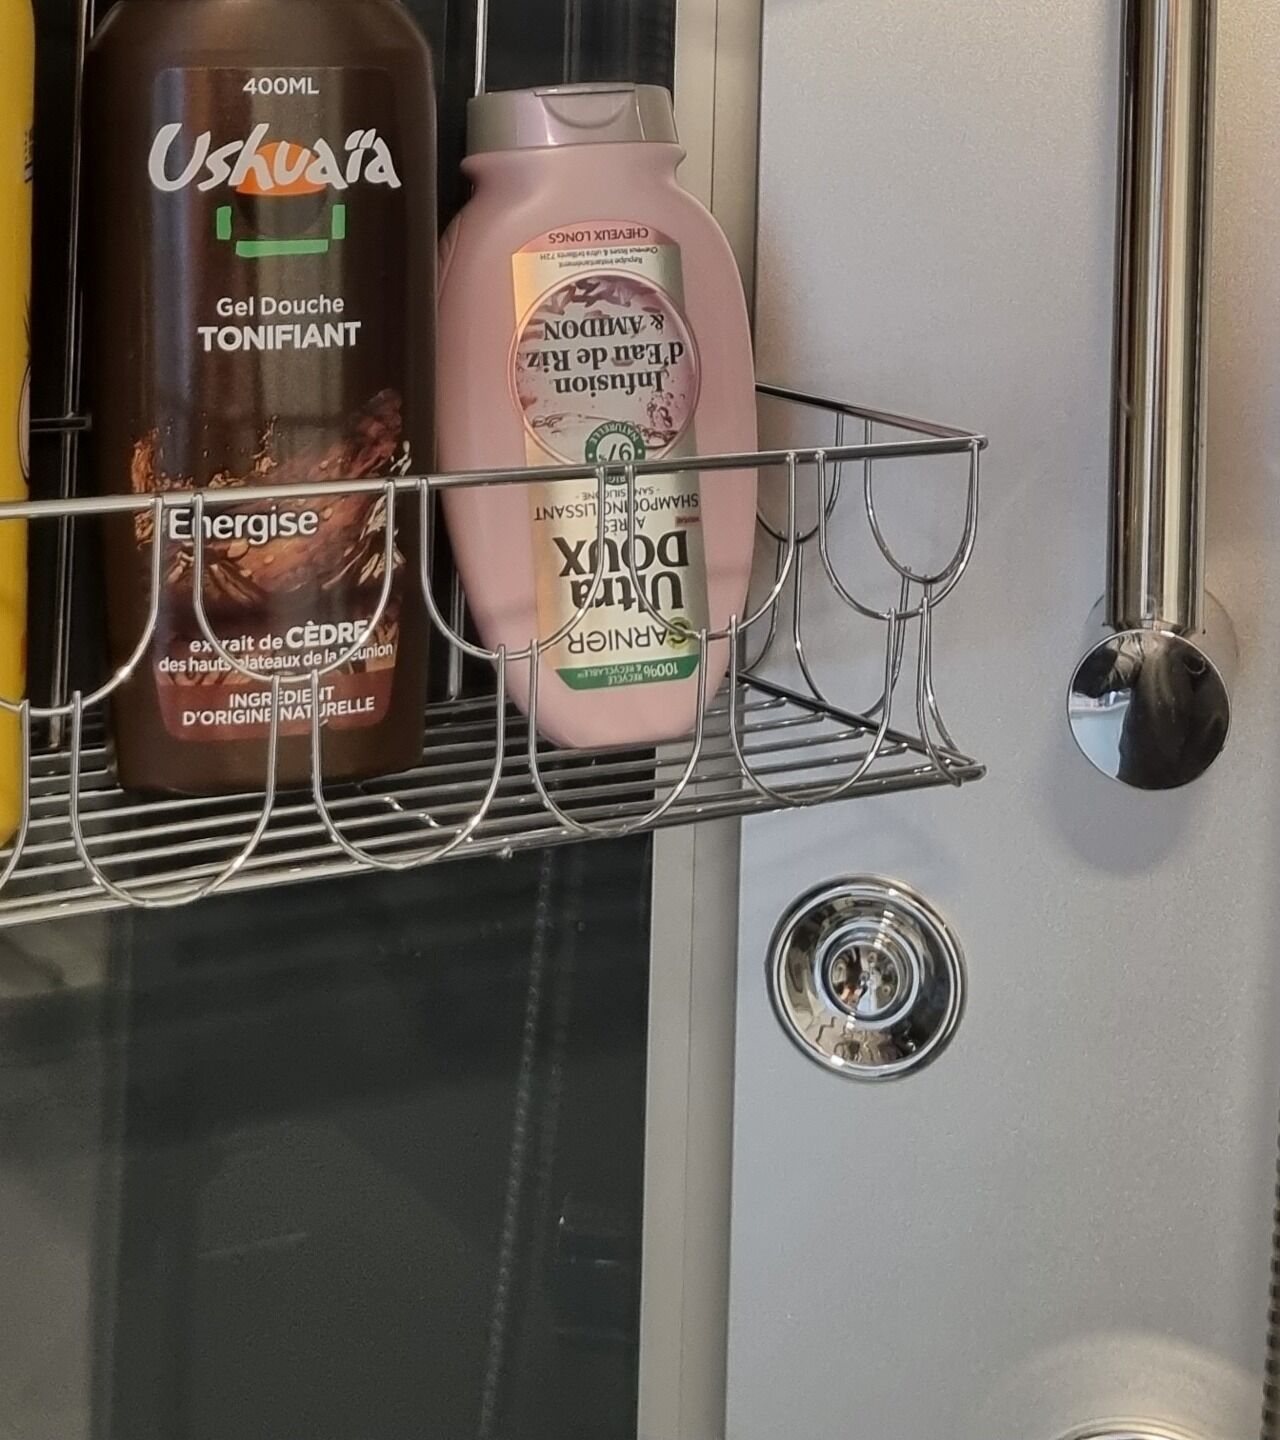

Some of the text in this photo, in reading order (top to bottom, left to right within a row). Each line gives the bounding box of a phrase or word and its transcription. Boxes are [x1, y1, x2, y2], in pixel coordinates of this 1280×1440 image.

[242, 77, 319, 95] 400ML
[147, 122, 403, 192] Ushuaïa
[548, 227, 649, 245] CHEVEUX LONGS
[216, 294, 345, 317] Gel Douche
[197, 321, 362, 352] TONIFIANT
[543, 313, 665, 341] & AMIDON
[526, 348, 572, 374] Riz
[576, 347, 608, 369] de
[553, 371, 664, 398] Infusion
[581, 487, 654, 501] SAN SILICNE
[534, 502, 597, 521] LISSANT
[169, 505, 319, 546] Energise
[596, 515, 646, 535] ARÈS-
[552, 529, 690, 577] DOUX
[570, 570, 684, 613] Ultra
[189, 620, 370, 653] exrait de CÈDRE
[567, 620, 690, 654] GARNIER
[158, 656, 187, 672] des
[302, 647, 323, 665] de
[324, 646, 337, 663] la
[643, 662, 679, 678] 100%
[280, 696, 375, 721] NATURELLE
